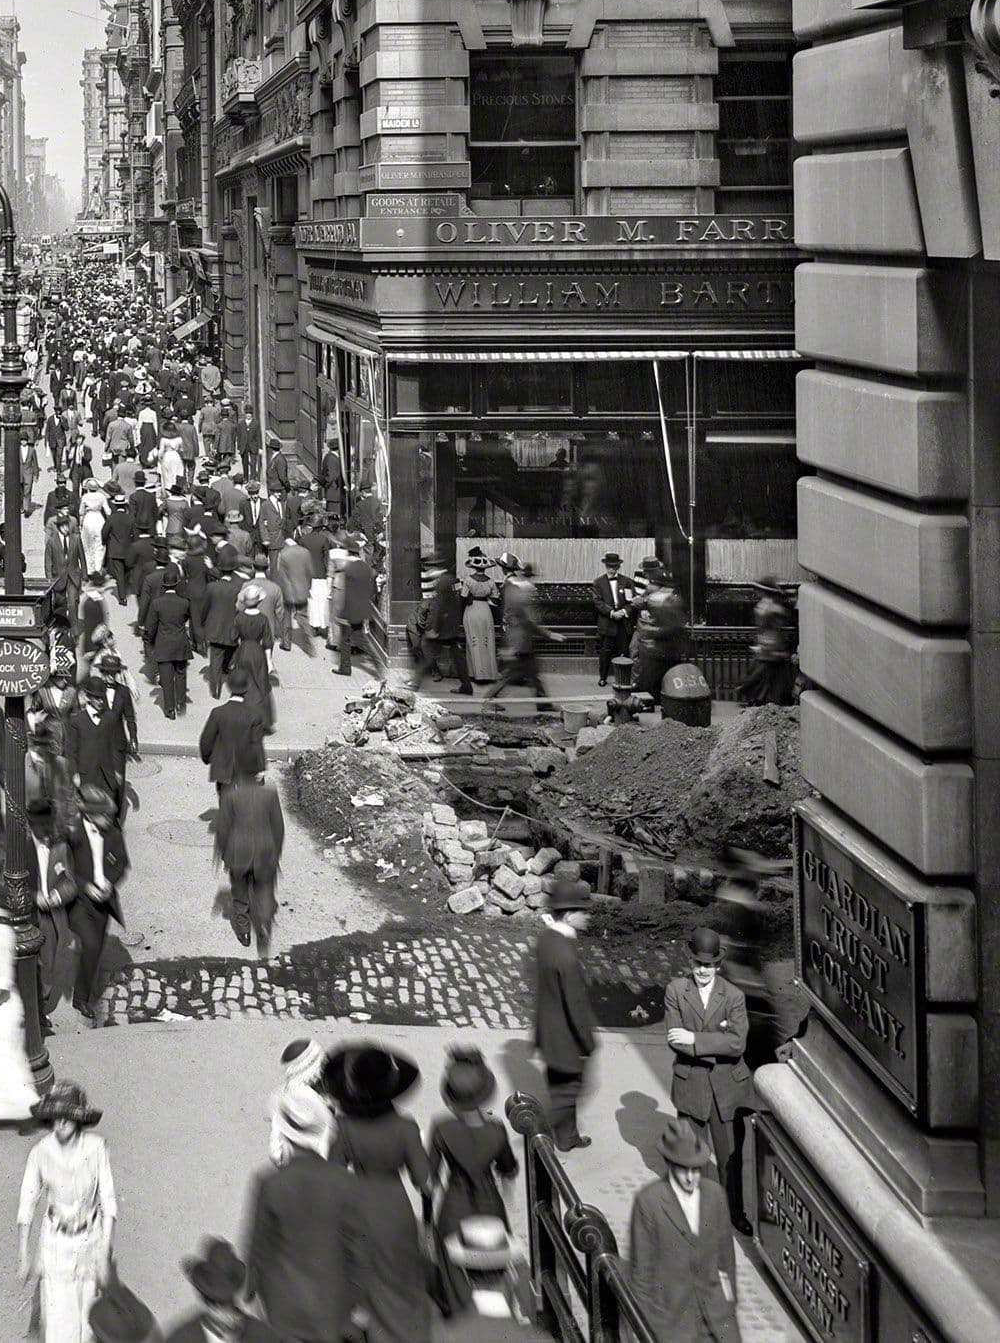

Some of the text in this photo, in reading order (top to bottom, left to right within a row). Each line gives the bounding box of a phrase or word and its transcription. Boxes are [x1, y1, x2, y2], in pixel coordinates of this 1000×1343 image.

[382, 119, 410, 128] MAIDEN
[371, 198, 404, 207] GOODS
[406, 198, 420, 207] AT
[435, 219, 795, 245] OLIVER M. FARR
[435, 280, 796, 307] WILLIAM BART
[802, 849, 911, 968] GUARDIAN
[821, 904, 890, 995] TRUST
[771, 1164, 844, 1278] MAIDEN LANE
[765, 1191, 851, 1323] SAFE DEPOSIT
